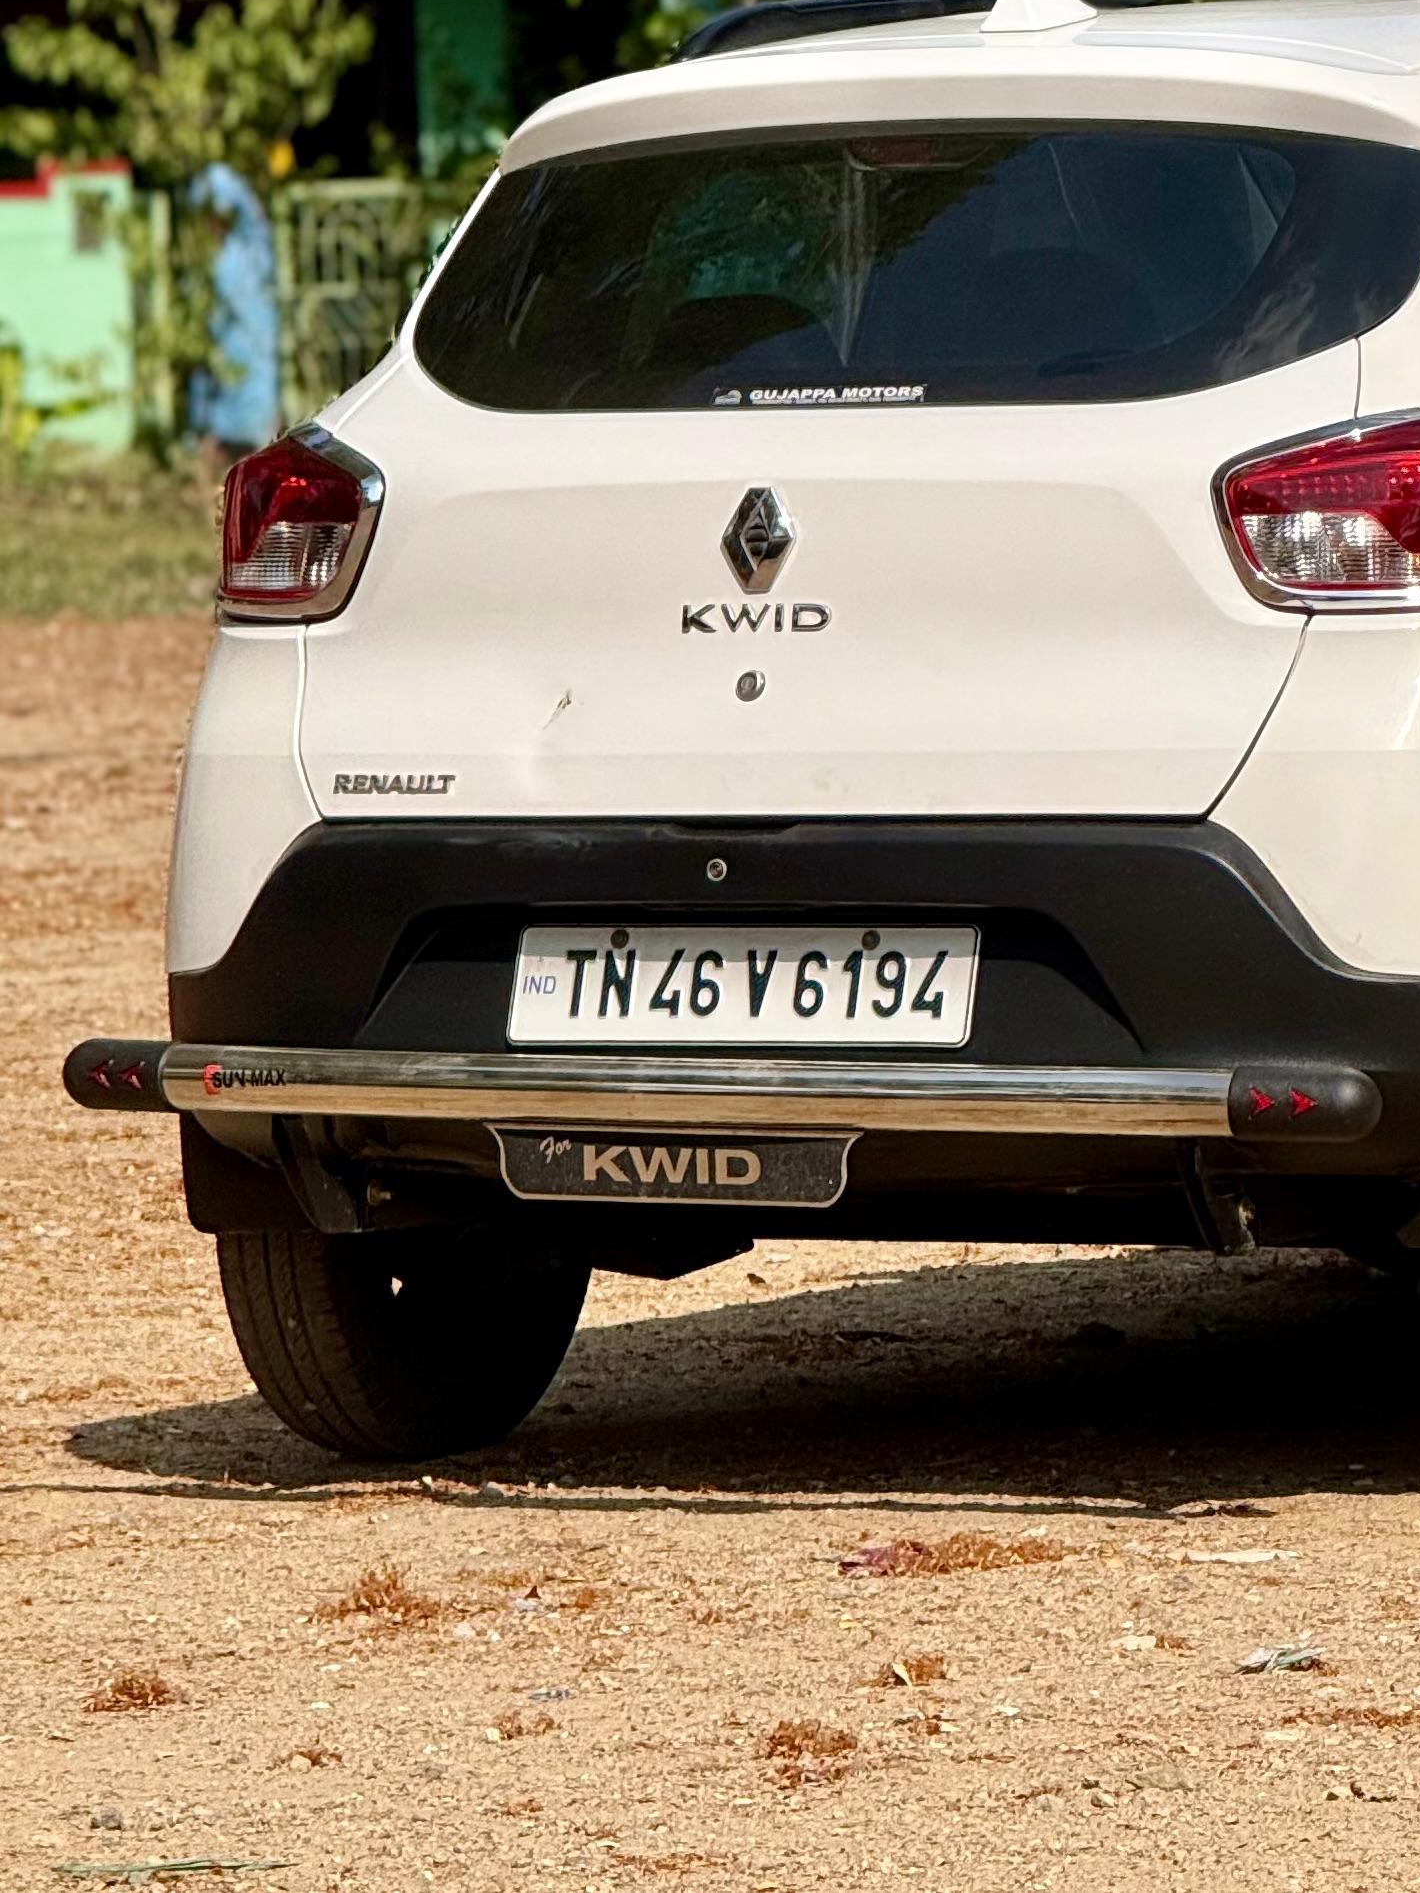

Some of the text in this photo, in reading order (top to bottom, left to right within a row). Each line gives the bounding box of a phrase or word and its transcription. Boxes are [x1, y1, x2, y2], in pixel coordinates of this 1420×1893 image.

[842, 385, 925, 397] MOTORS
[680, 603, 833, 634] KWID
[332, 774, 456, 795] RENAULT
[522, 975, 557, 995] IND
[566, 948, 949, 1021] TN 46 V 6194
[539, 1135, 762, 1186] For KWID
